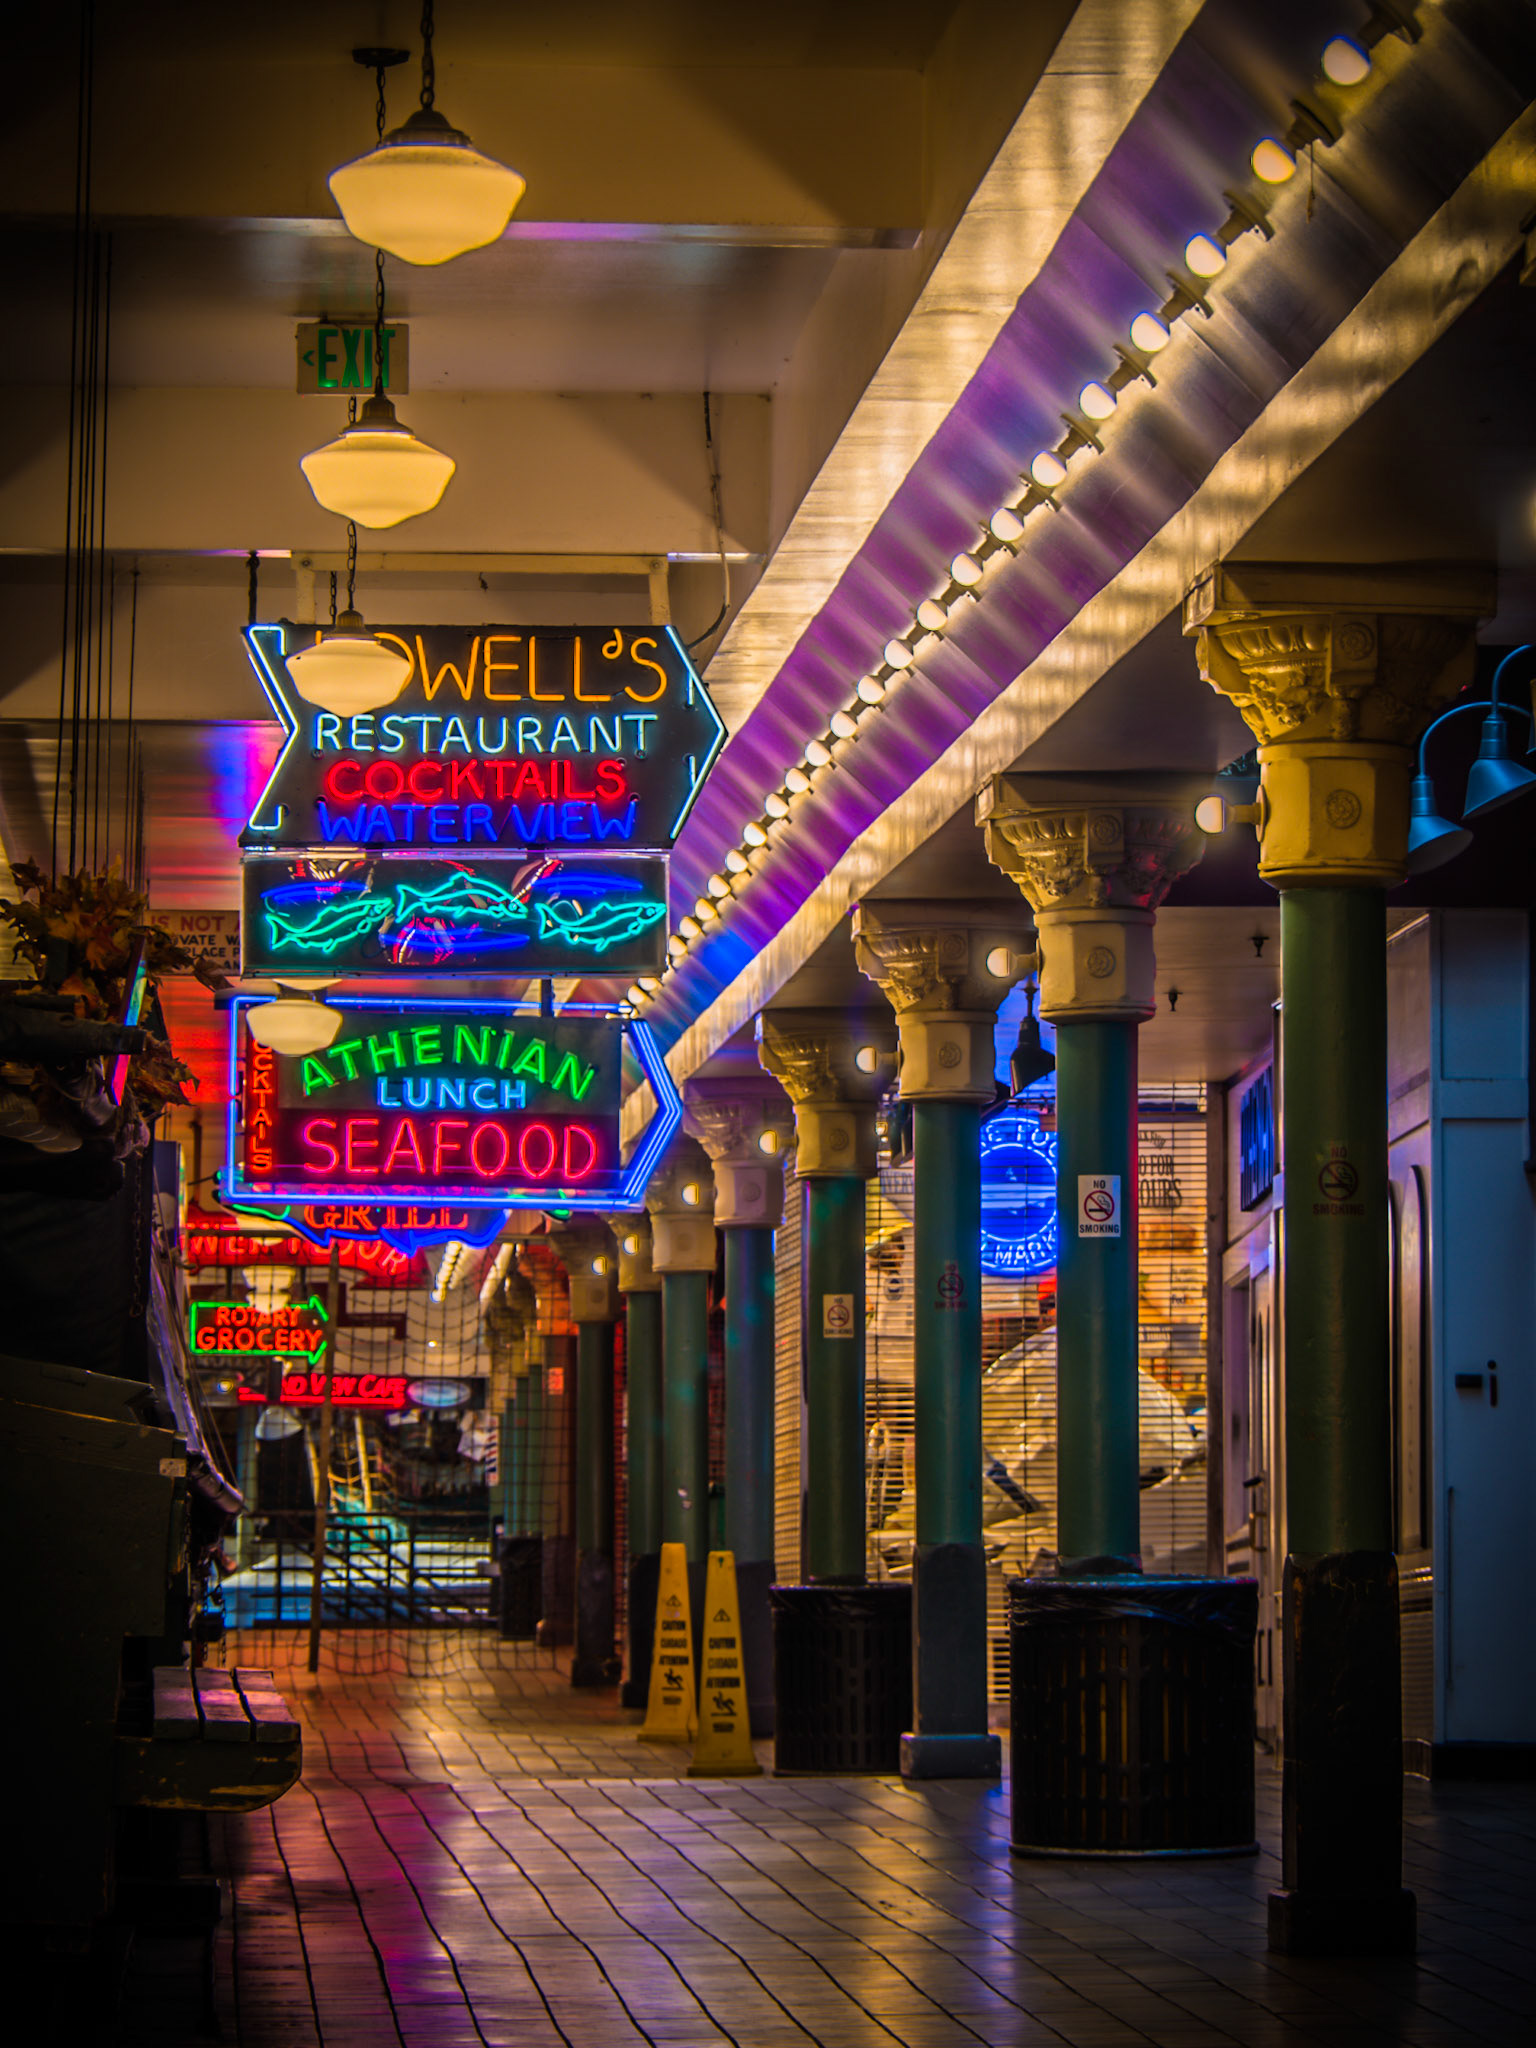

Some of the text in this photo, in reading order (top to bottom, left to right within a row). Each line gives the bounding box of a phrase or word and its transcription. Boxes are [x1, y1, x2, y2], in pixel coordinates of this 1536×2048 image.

[318, 329, 396, 388] EXIT
[316, 628, 668, 704] WELL'S
[316, 714, 658, 754] RESTAURANT
[327, 760, 626, 800] COCKTAILS
[320, 801, 636, 844] WATER VIEW
[181, 915, 225, 932] NOT
[302, 1023, 595, 1101] ATHENIAN
[377, 1076, 528, 1109] LUNCH
[303, 1117, 599, 1181] SEAFOOD
[1331, 1146, 1348, 1158] NO
[1093, 1180, 1106, 1189] NO
[1140, 1178, 1182, 1208] OURS
[1312, 1203, 1365, 1216] SMOKING
[1079, 1224, 1120, 1234] SMOKING
[216, 1306, 301, 1328] ROTARY
[196, 1326, 323, 1352] GROCERY
